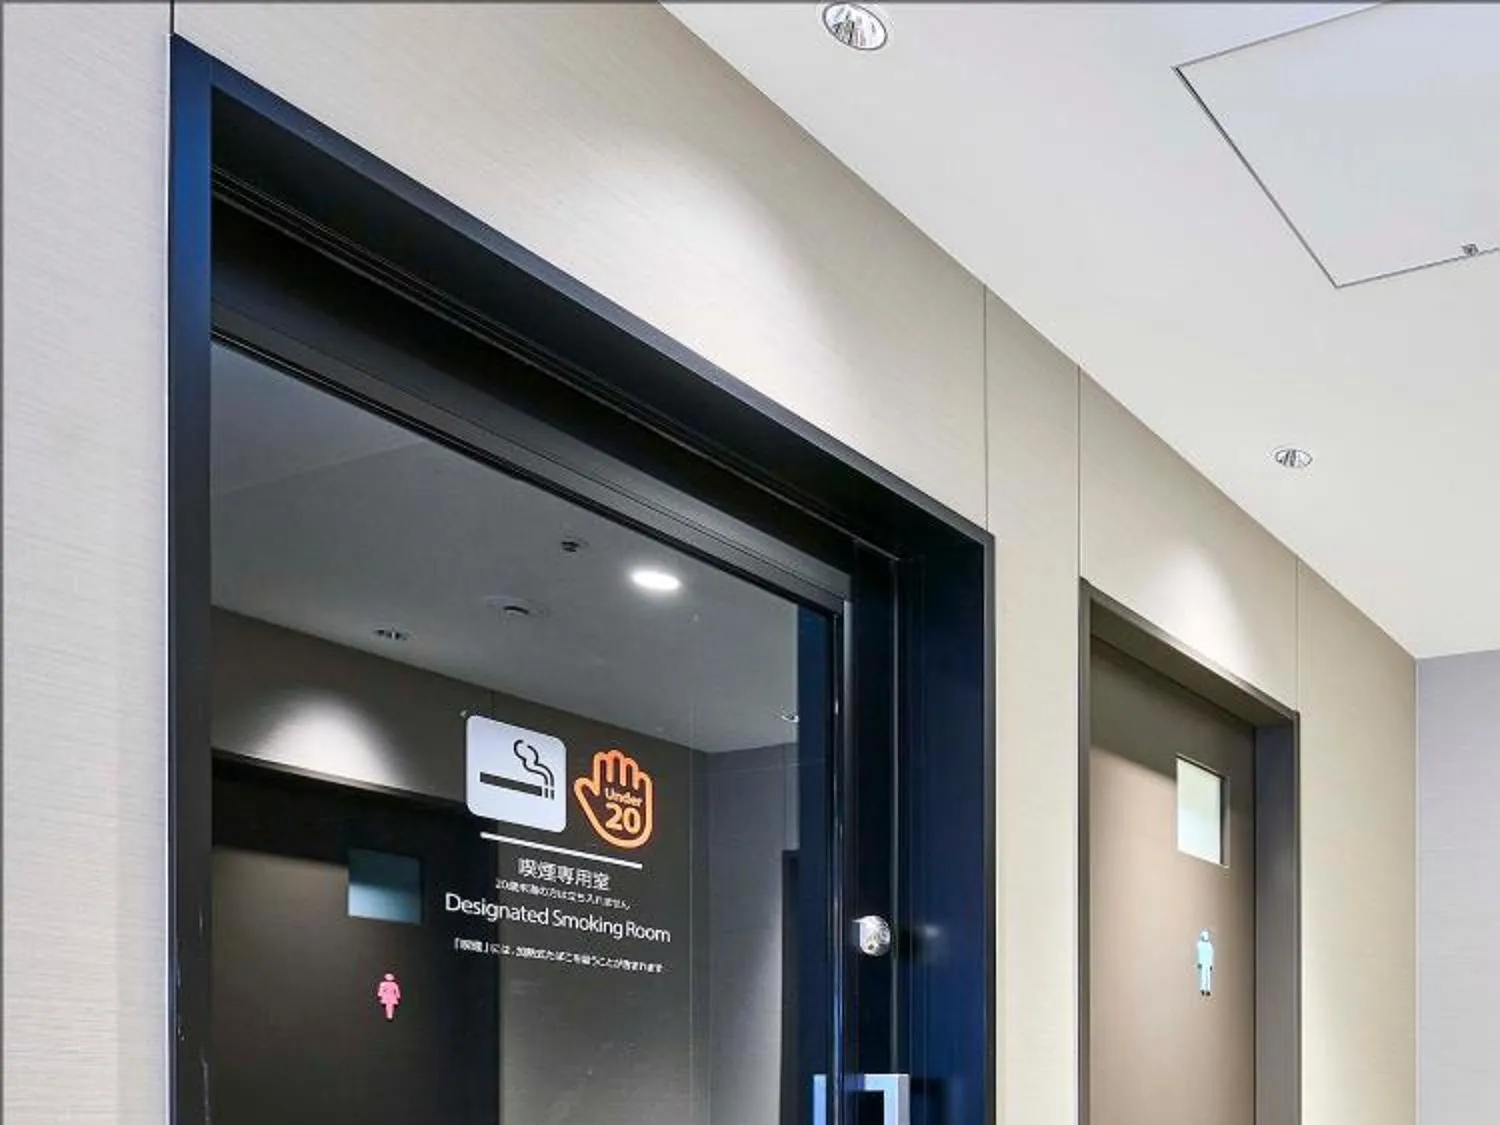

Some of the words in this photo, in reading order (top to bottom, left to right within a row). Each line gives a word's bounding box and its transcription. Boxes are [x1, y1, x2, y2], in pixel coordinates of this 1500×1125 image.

[605, 787, 643, 807] Under
[605, 803, 641, 834] 20
[445, 892, 548, 926] Designated
[552, 911, 623, 940] Smoking
[626, 921, 671, 943] Room
